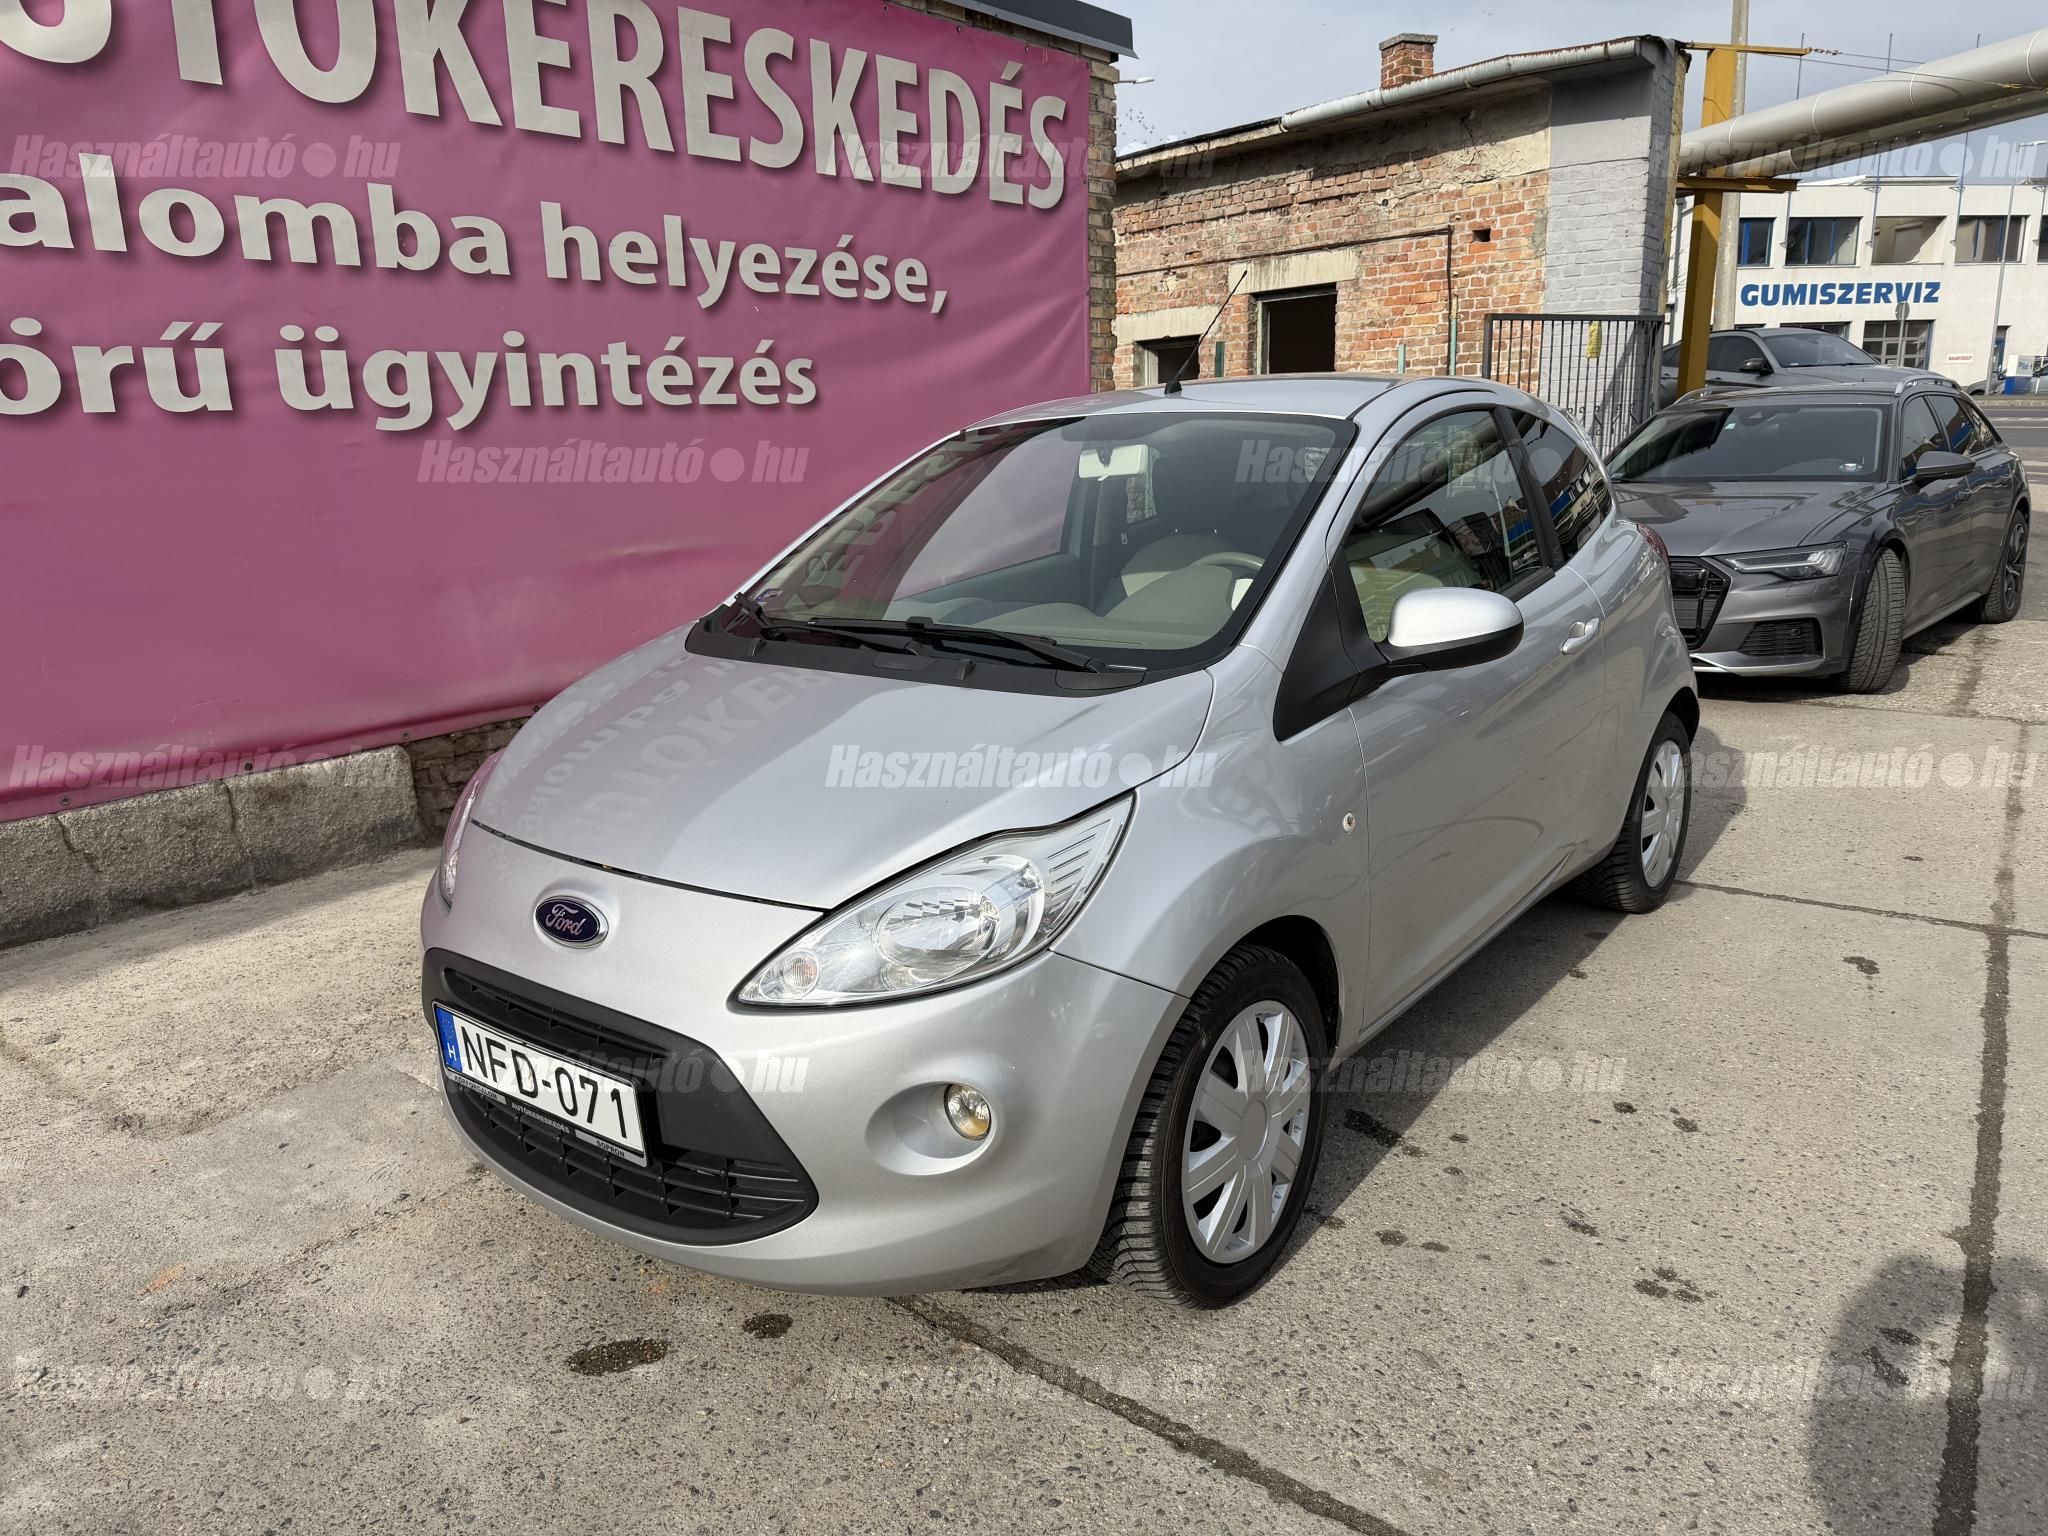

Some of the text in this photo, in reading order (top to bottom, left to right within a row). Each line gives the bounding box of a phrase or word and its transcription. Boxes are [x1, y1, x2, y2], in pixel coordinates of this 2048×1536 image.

[540, 201, 947, 313] helyezése,
[1740, 281, 1941, 307] GUMISZERVIZ
[275, 325, 817, 431] ügyintézés
[545, 904, 586, 936] Ford
[447, 1026, 628, 1138] H NFD-071
